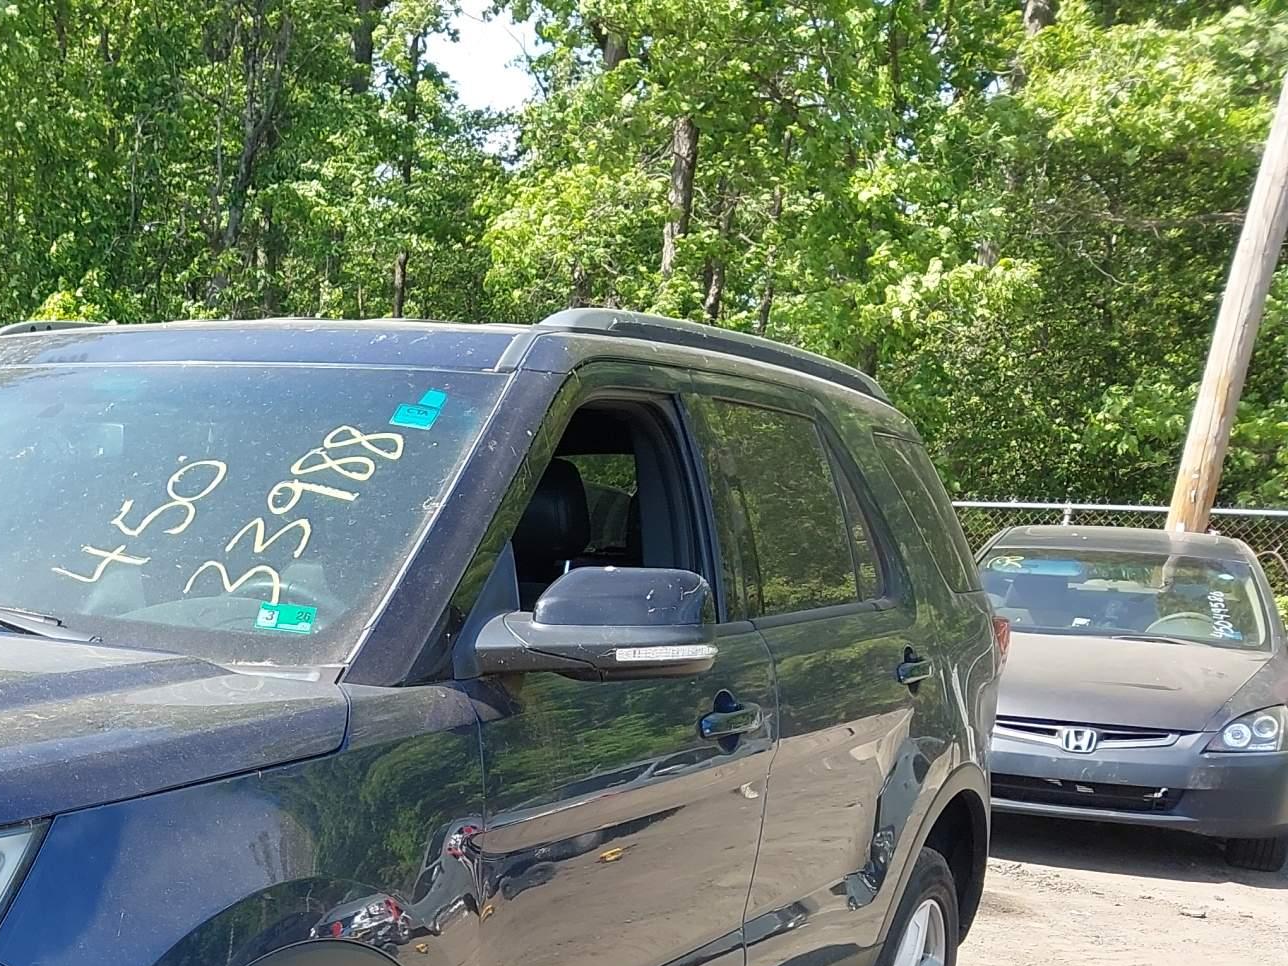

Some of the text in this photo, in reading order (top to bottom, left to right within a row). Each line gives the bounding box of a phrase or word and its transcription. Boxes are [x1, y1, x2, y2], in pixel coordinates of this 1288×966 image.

[50, 458, 228, 584] 450
[182, 424, 405, 606] 33988
[265, 610, 312, 623] 3 26
